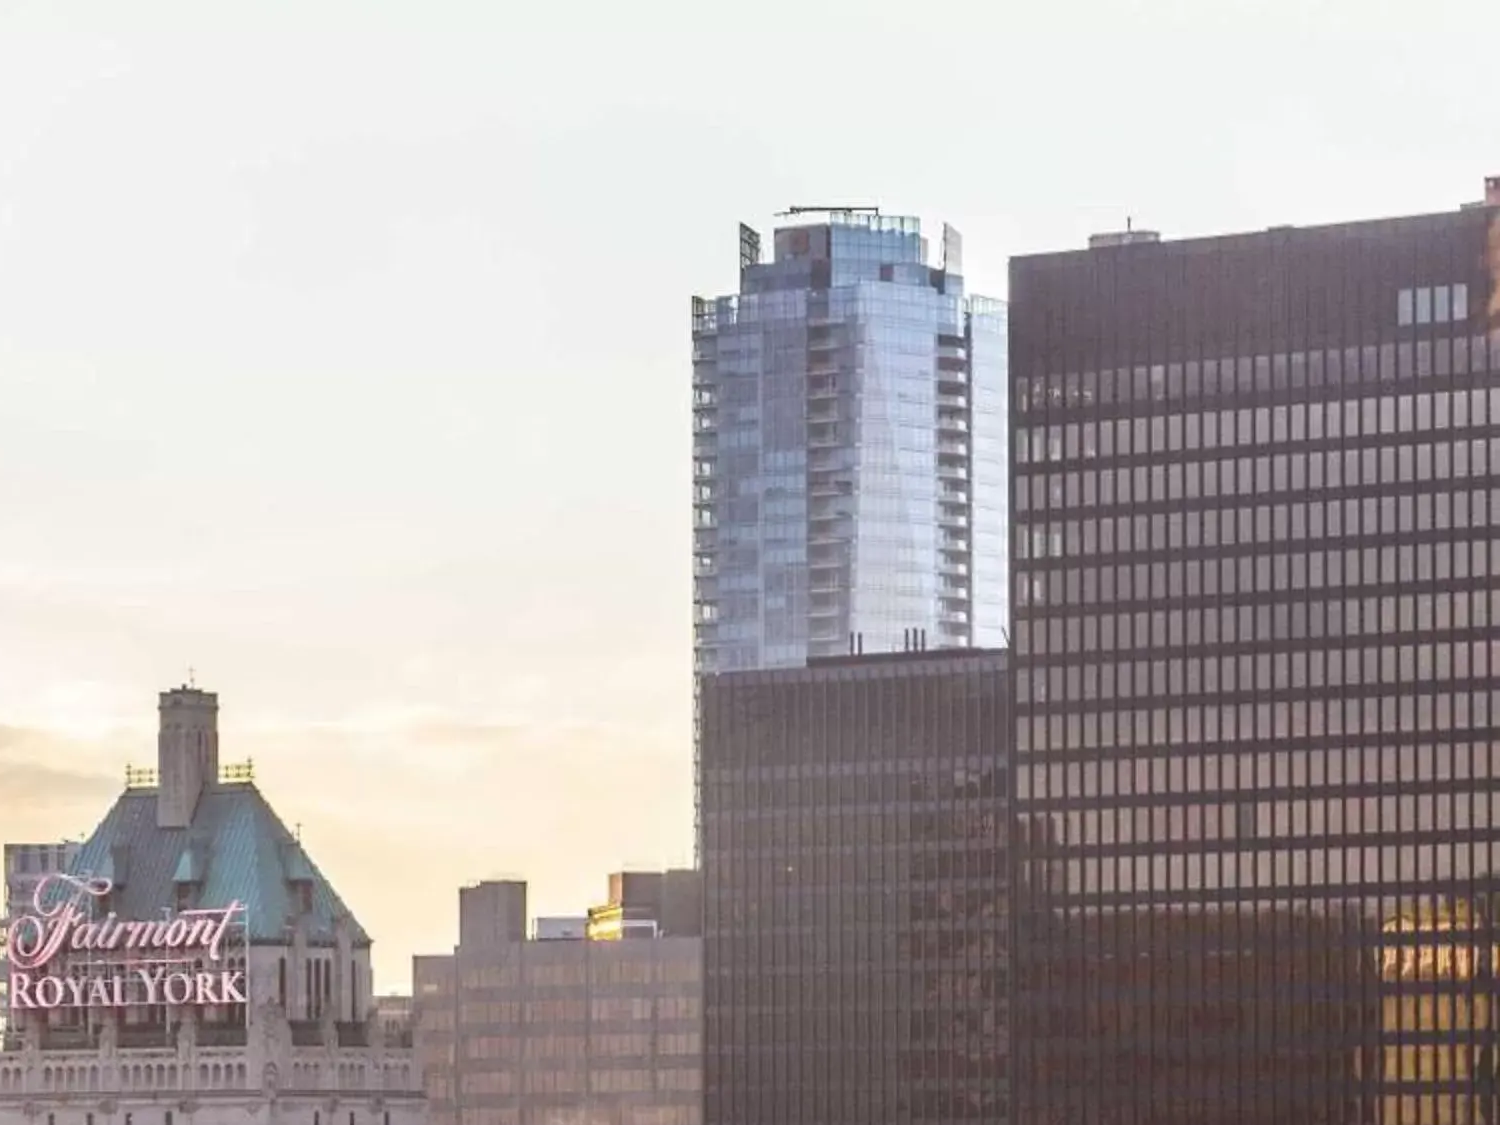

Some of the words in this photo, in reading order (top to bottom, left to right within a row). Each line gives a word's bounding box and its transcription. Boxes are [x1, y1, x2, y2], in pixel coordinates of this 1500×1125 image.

[8, 873, 246, 968] Fairmont
[10, 972, 126, 1008] ROYAL
[136, 967, 247, 1005] YORK
